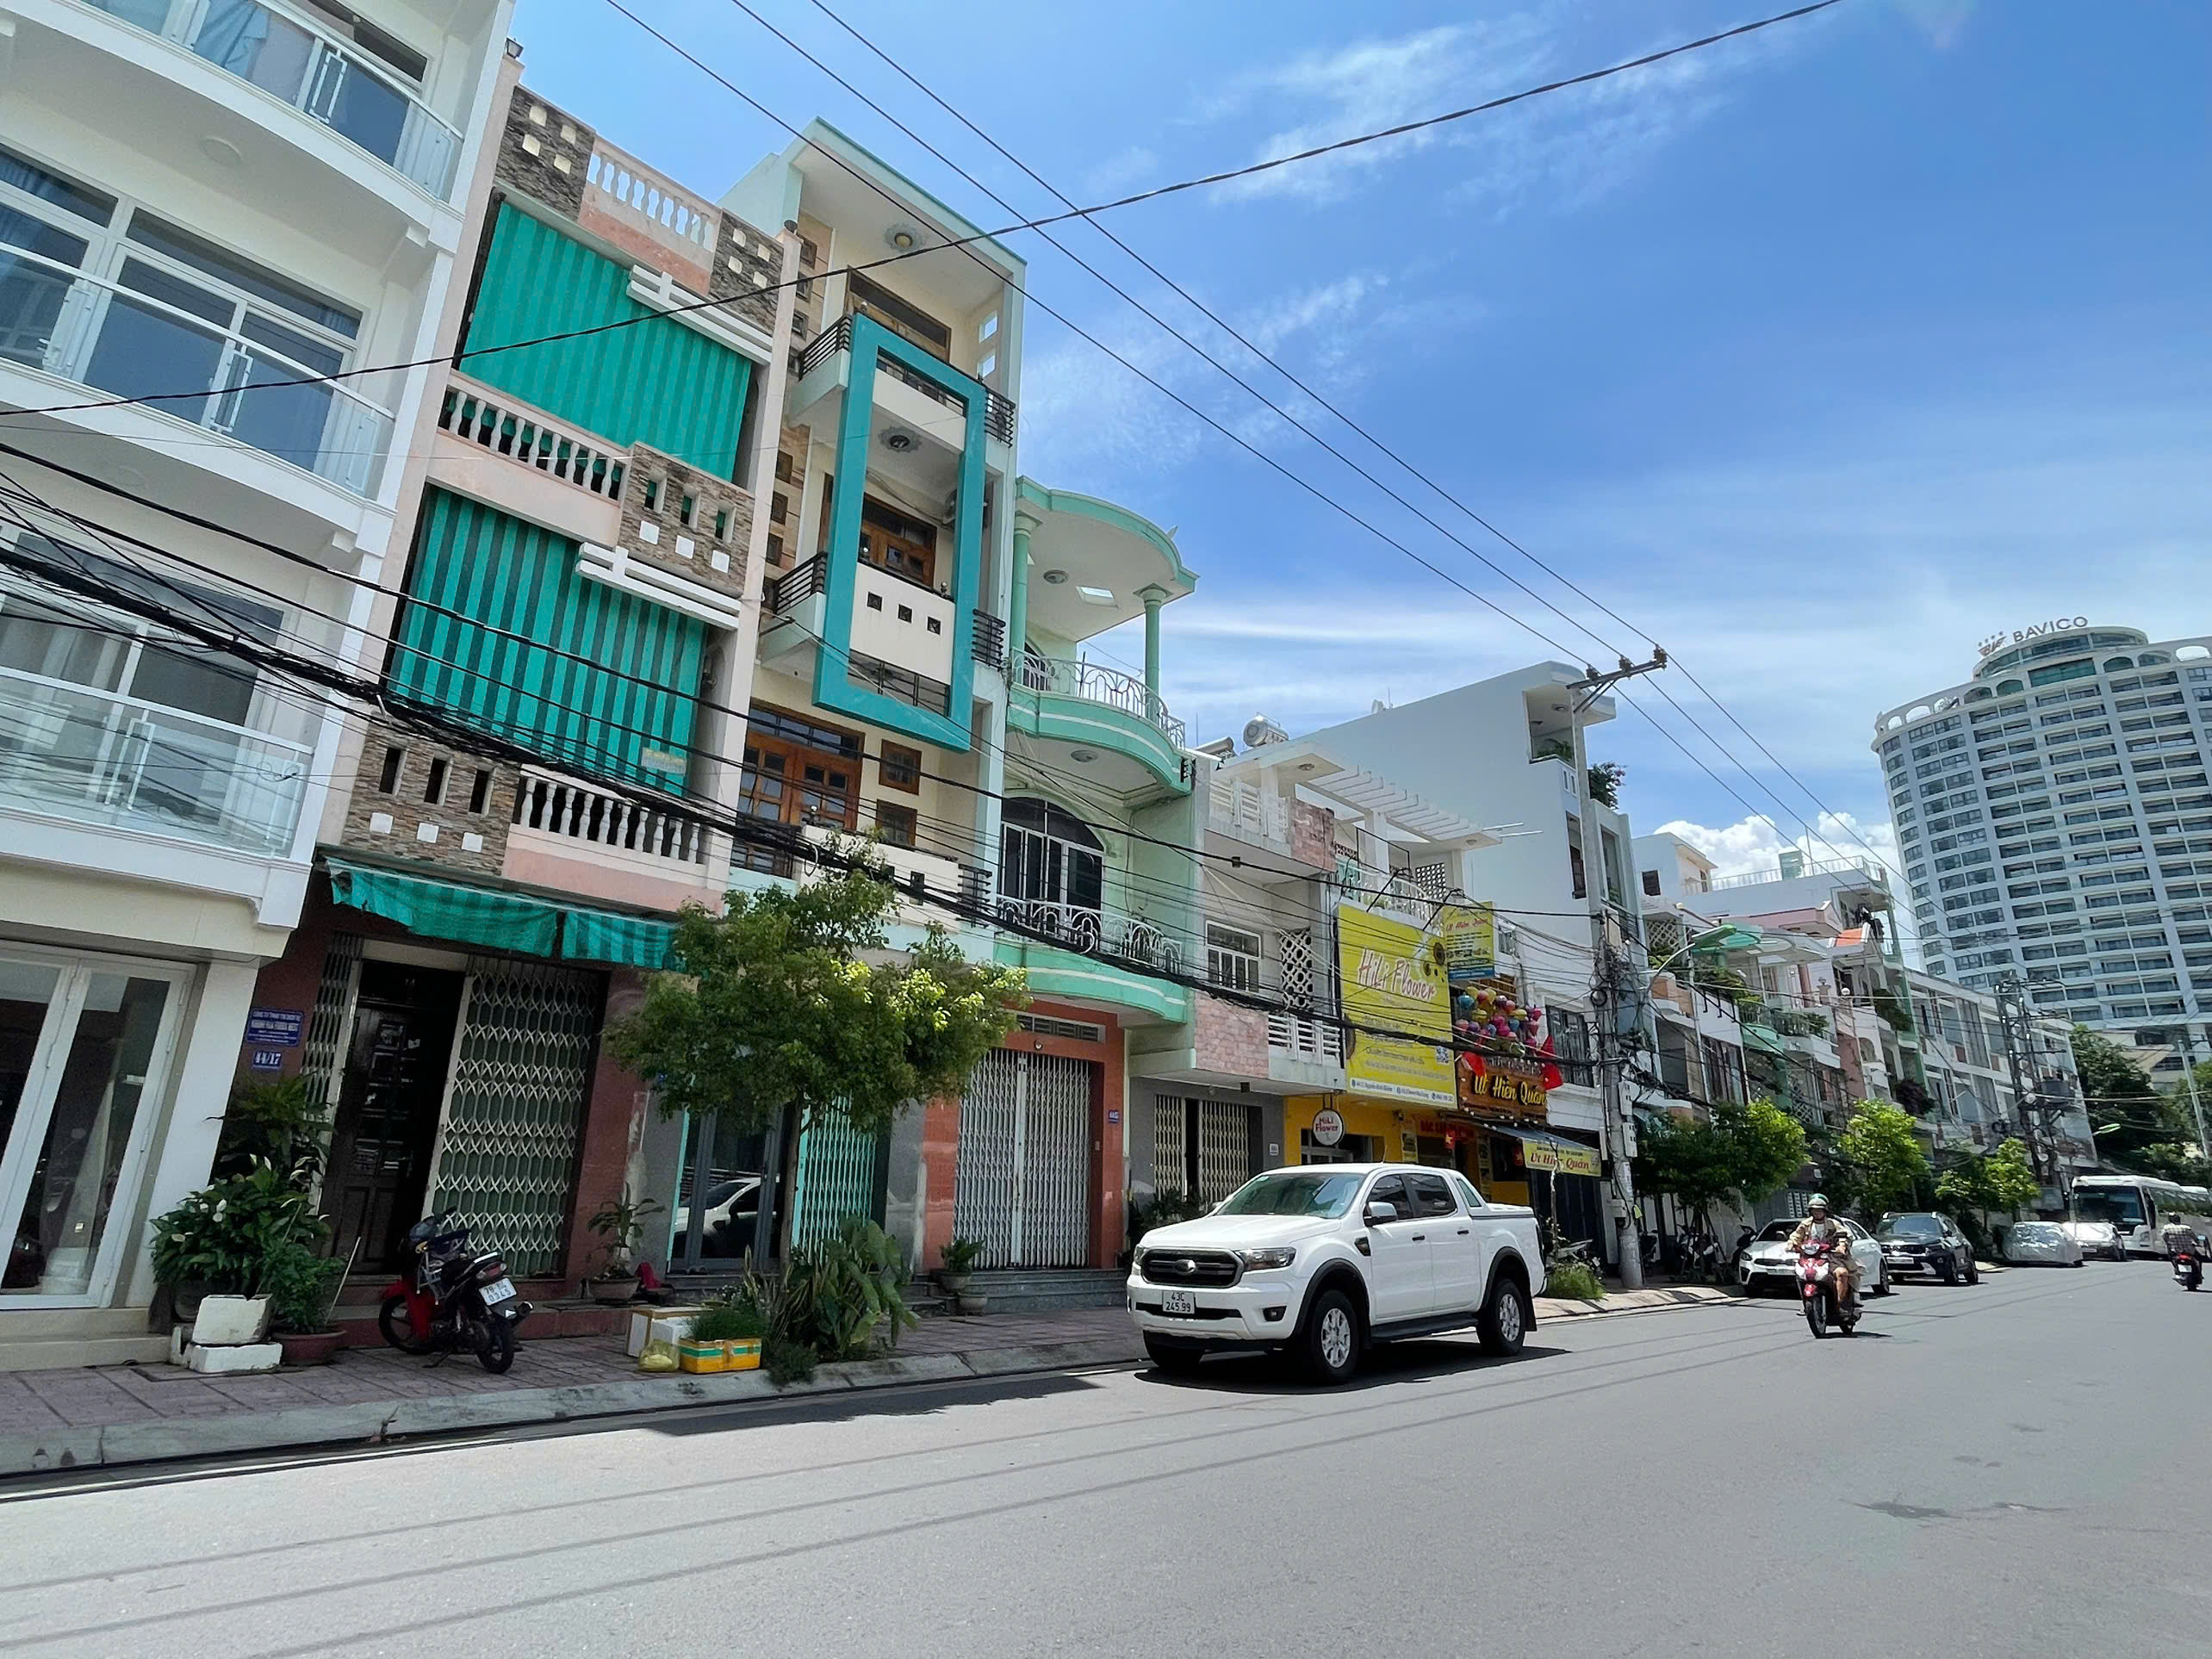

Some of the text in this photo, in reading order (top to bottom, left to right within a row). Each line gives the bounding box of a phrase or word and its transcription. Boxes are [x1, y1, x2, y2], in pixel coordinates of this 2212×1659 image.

[2012, 616, 2088, 643] BAVICO
[1391, 959, 1437, 1001] Flower
[1171, 1293, 1185, 1302] 43C
